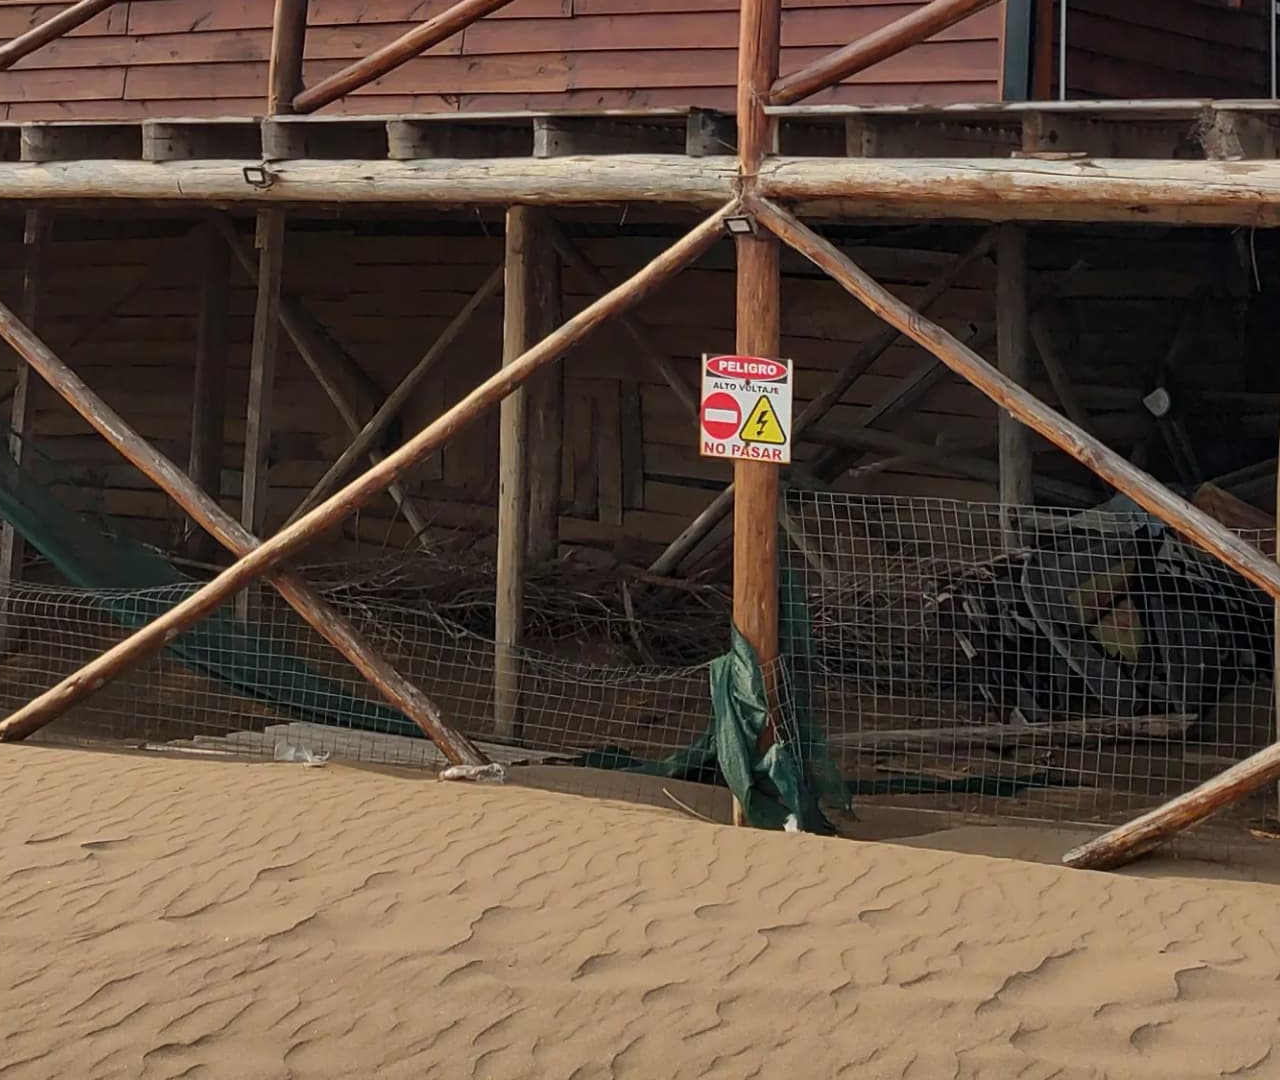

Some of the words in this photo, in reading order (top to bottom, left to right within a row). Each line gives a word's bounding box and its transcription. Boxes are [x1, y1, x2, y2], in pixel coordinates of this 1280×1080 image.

[718, 360, 777, 376] PELIGRO
[713, 382, 737, 391] ALTO
[739, 384, 780, 395] VOLTAJE
[704, 442, 726, 454] NO
[731, 444, 783, 461] PASAR
